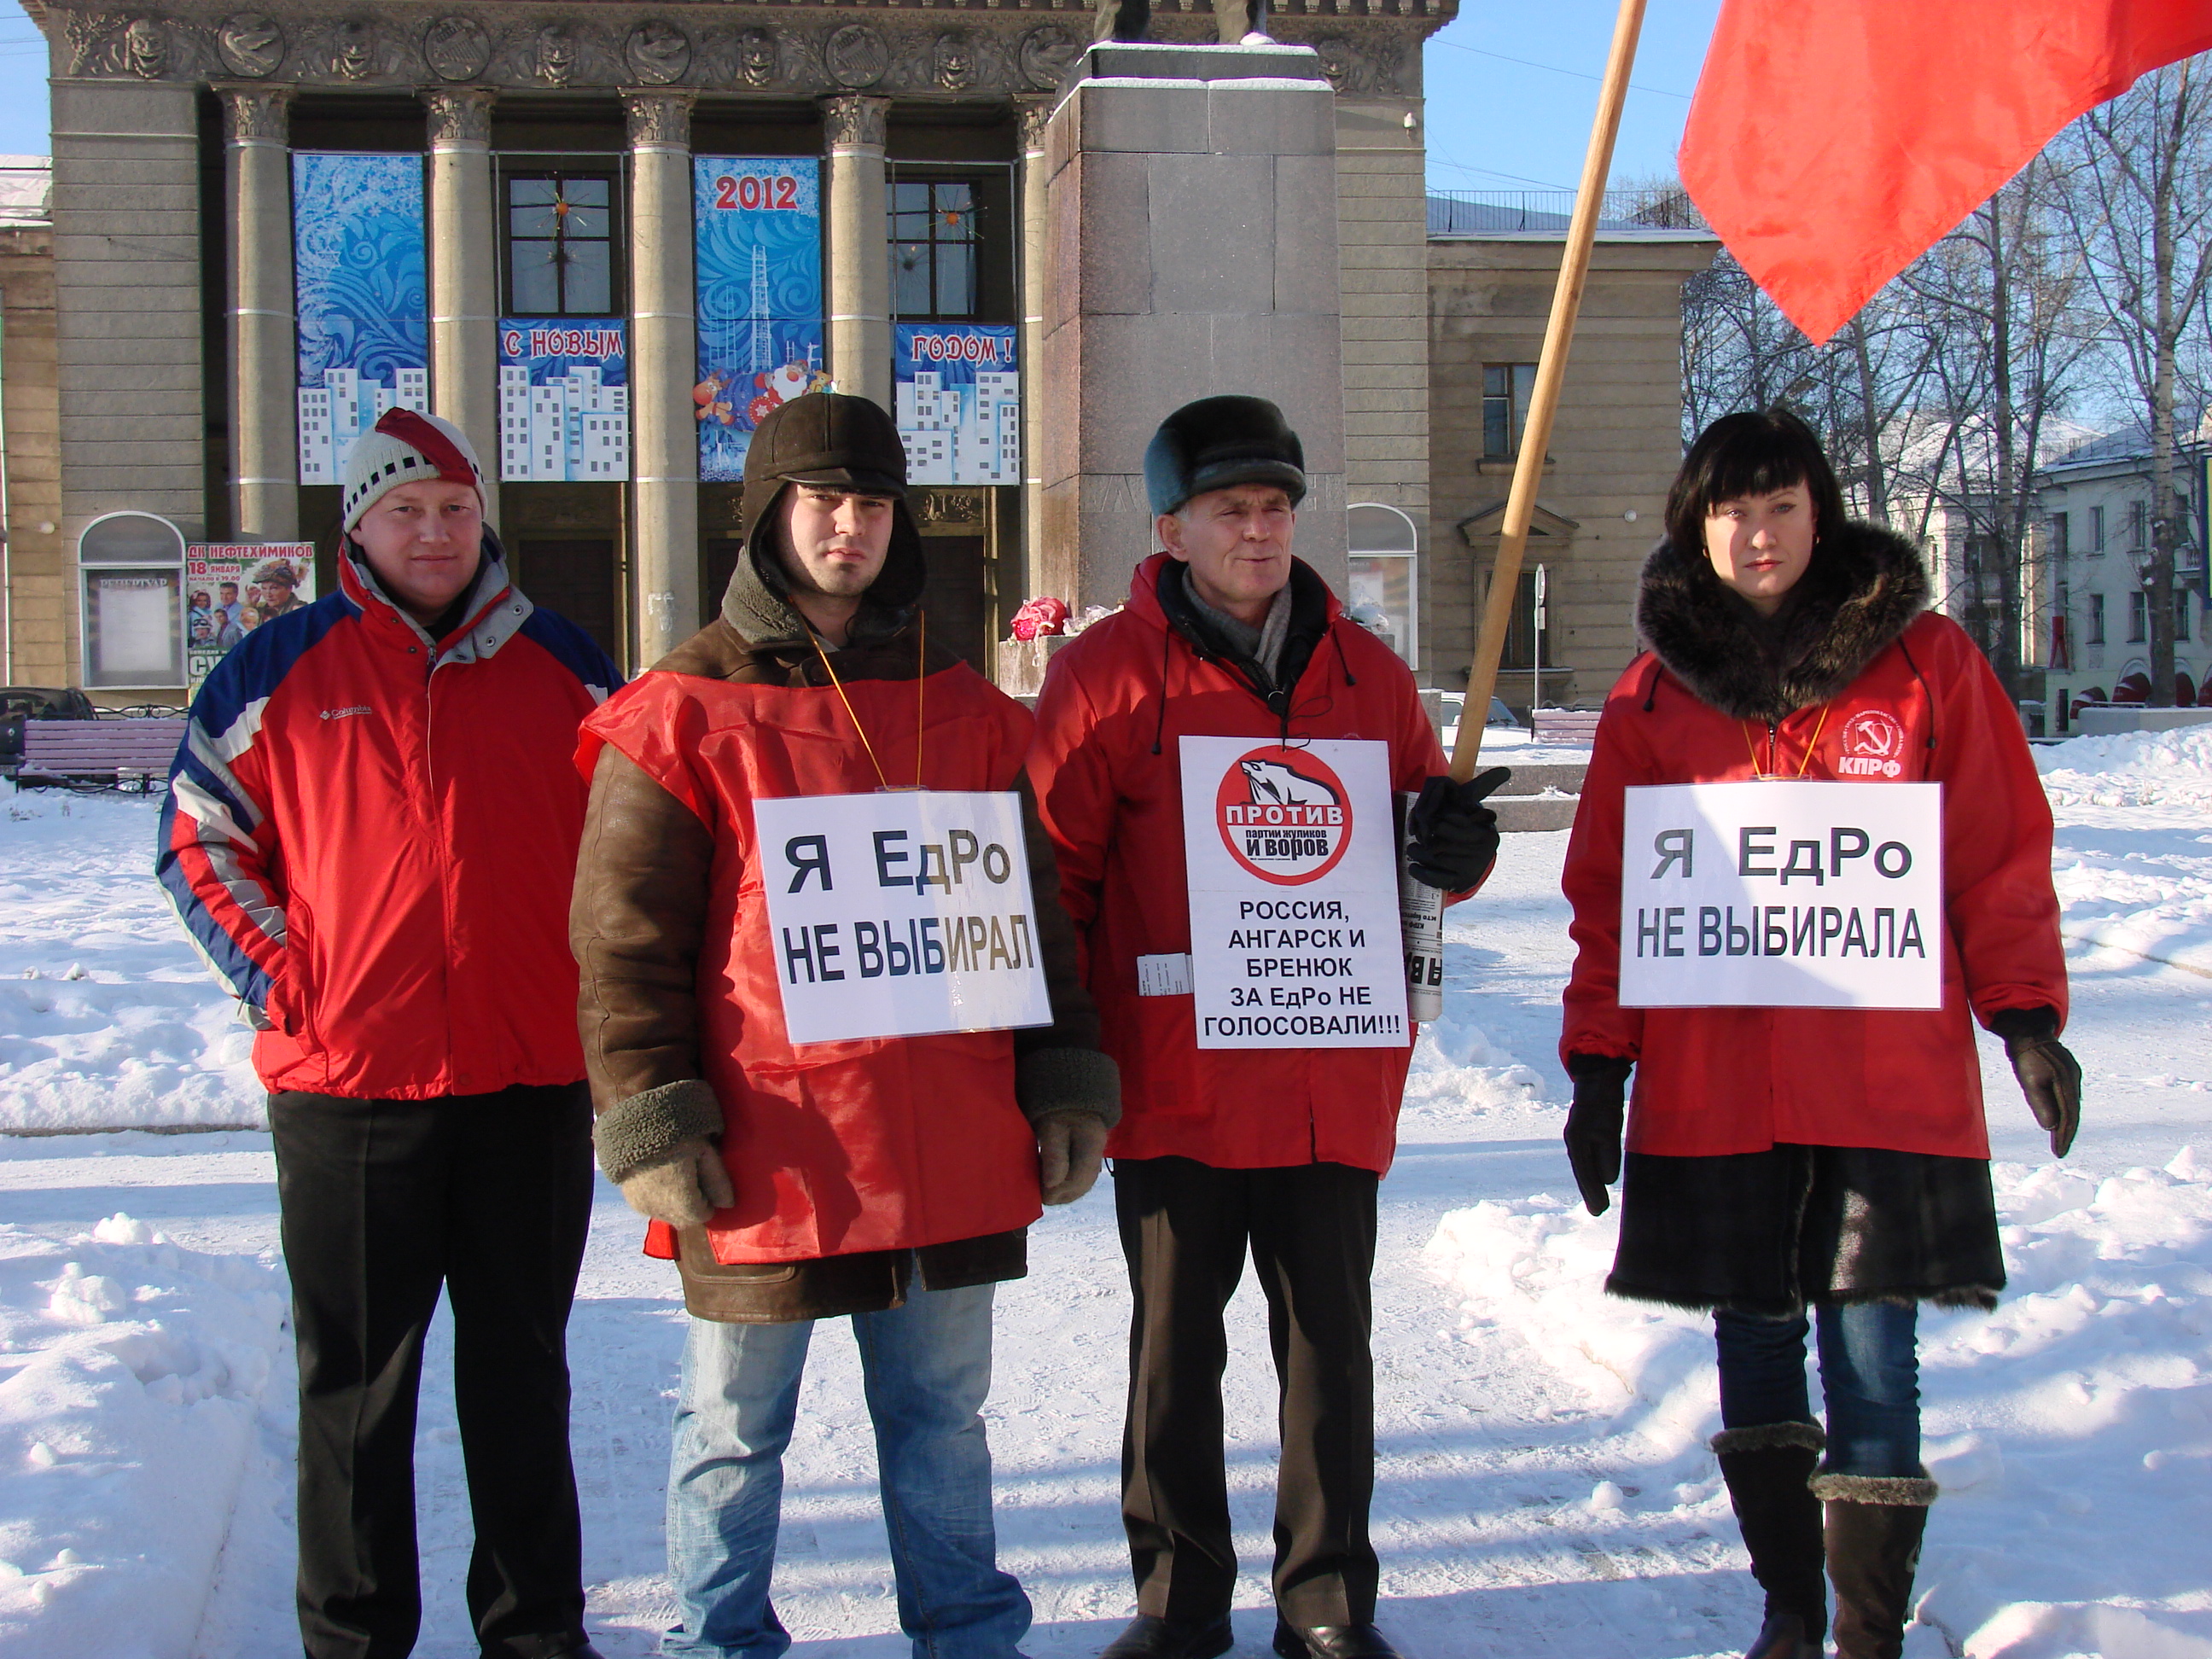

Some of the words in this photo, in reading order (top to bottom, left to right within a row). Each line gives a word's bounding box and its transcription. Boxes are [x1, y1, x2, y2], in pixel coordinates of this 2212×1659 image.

[715, 175, 799, 211] 2012
[504, 329, 523, 357] С
[530, 329, 625, 363] НОВЫМ
[188, 545, 206, 558] ДК
[209, 545, 313, 558] НЕФТЕХИМИКОВ
[189, 562, 207, 574] 18
[210, 564, 241, 573] ЯНВАРЯ
[331, 704, 371, 717] Columbia
[1838, 756, 1901, 778] КПРФ
[1225, 805, 1344, 825] ПРОТИВ
[1245, 830, 1281, 839] партии
[1283, 830, 1327, 839] жуликов
[785, 835, 833, 894] Я
[872, 830, 1010, 896] ЕдРо
[1650, 829, 1694, 879] Я
[1738, 826, 1912, 886] ЕдРо
[1239, 900, 1349, 922] РОССИЯ,
[1228, 928, 1342, 949] АНГАРСК
[1348, 928, 1365, 948] И
[1637, 906, 1685, 958] НЕ
[1698, 905, 1926, 959] ВЫБИРАЛА
[783, 923, 845, 984] НЕ
[853, 914, 1034, 979] ВЫБИРАЛ
[1247, 958, 1353, 978] БРЕНЮК
[1231, 987, 1263, 1006] ЗА
[1270, 987, 1331, 1010] ЕдРо
[1340, 986, 1371, 1005] НЕ
[1203, 1015, 1400, 1036] ГОЛОСОВАЛИ!!!
